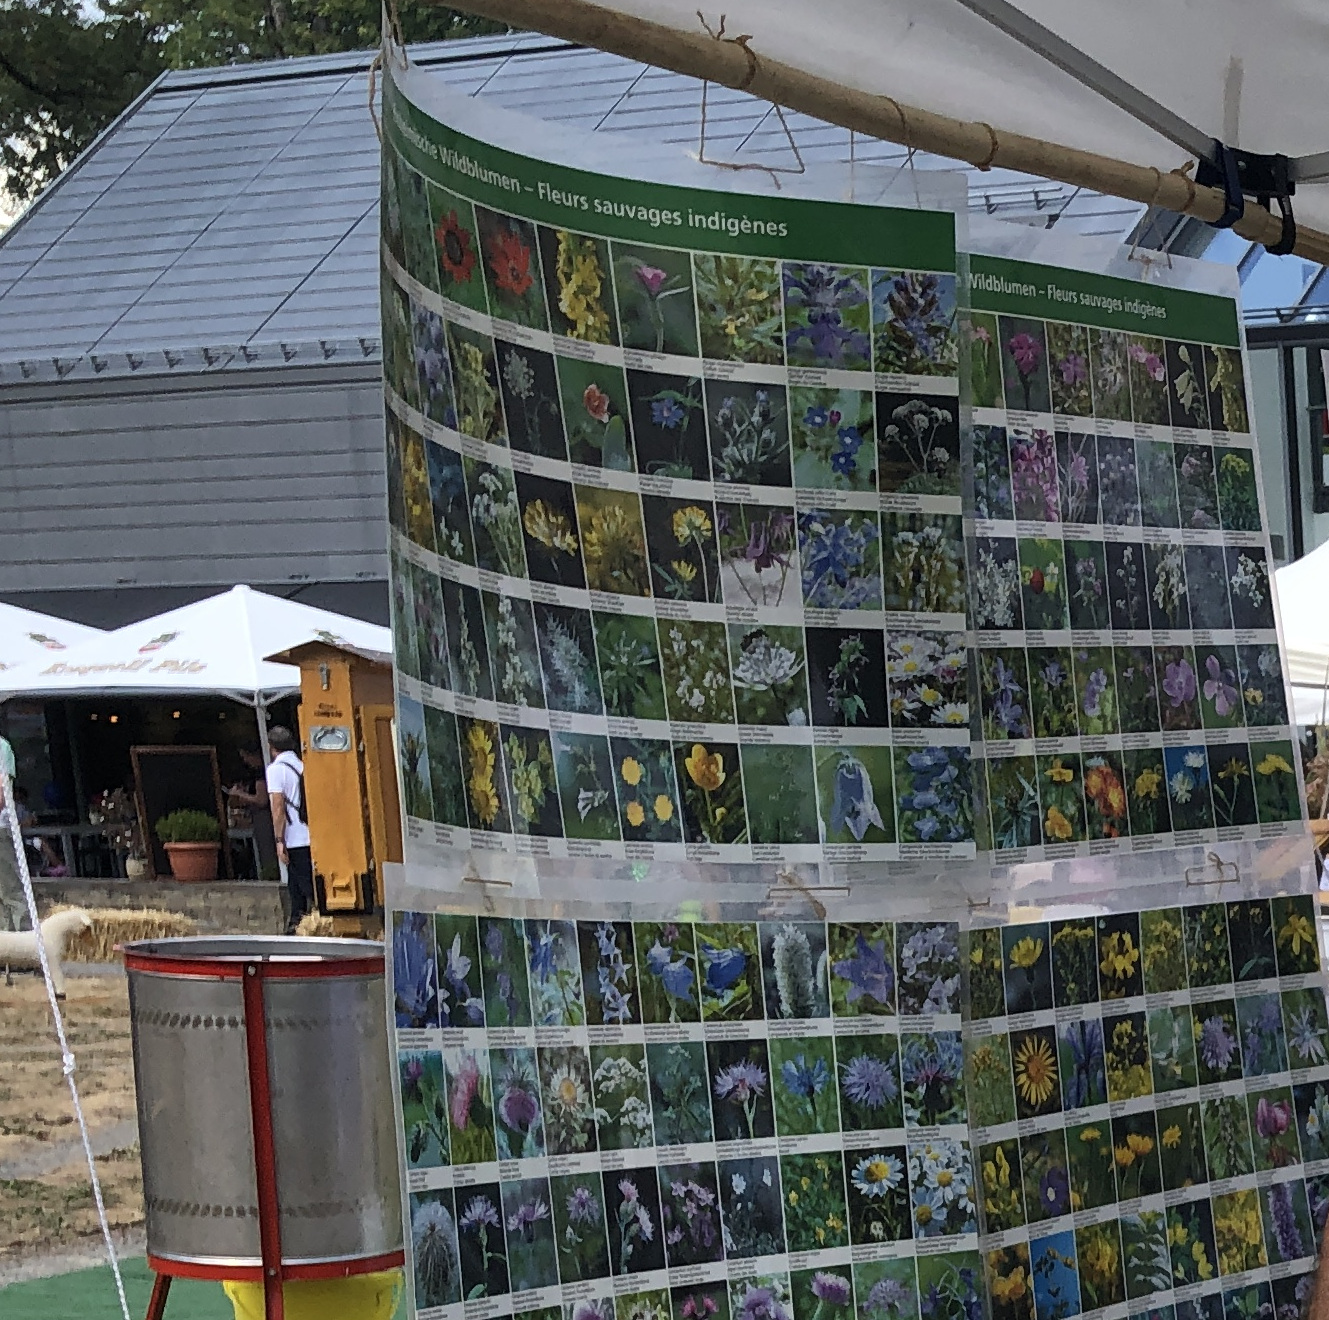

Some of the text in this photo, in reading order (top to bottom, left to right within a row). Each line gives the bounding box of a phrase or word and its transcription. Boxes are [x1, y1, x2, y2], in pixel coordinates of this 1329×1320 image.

[439, 143, 788, 237] Wildblumen Fleurs sauvages indigènes
[969, 273, 1167, 320] Wildblumen Fleurs sauvages indigènes
